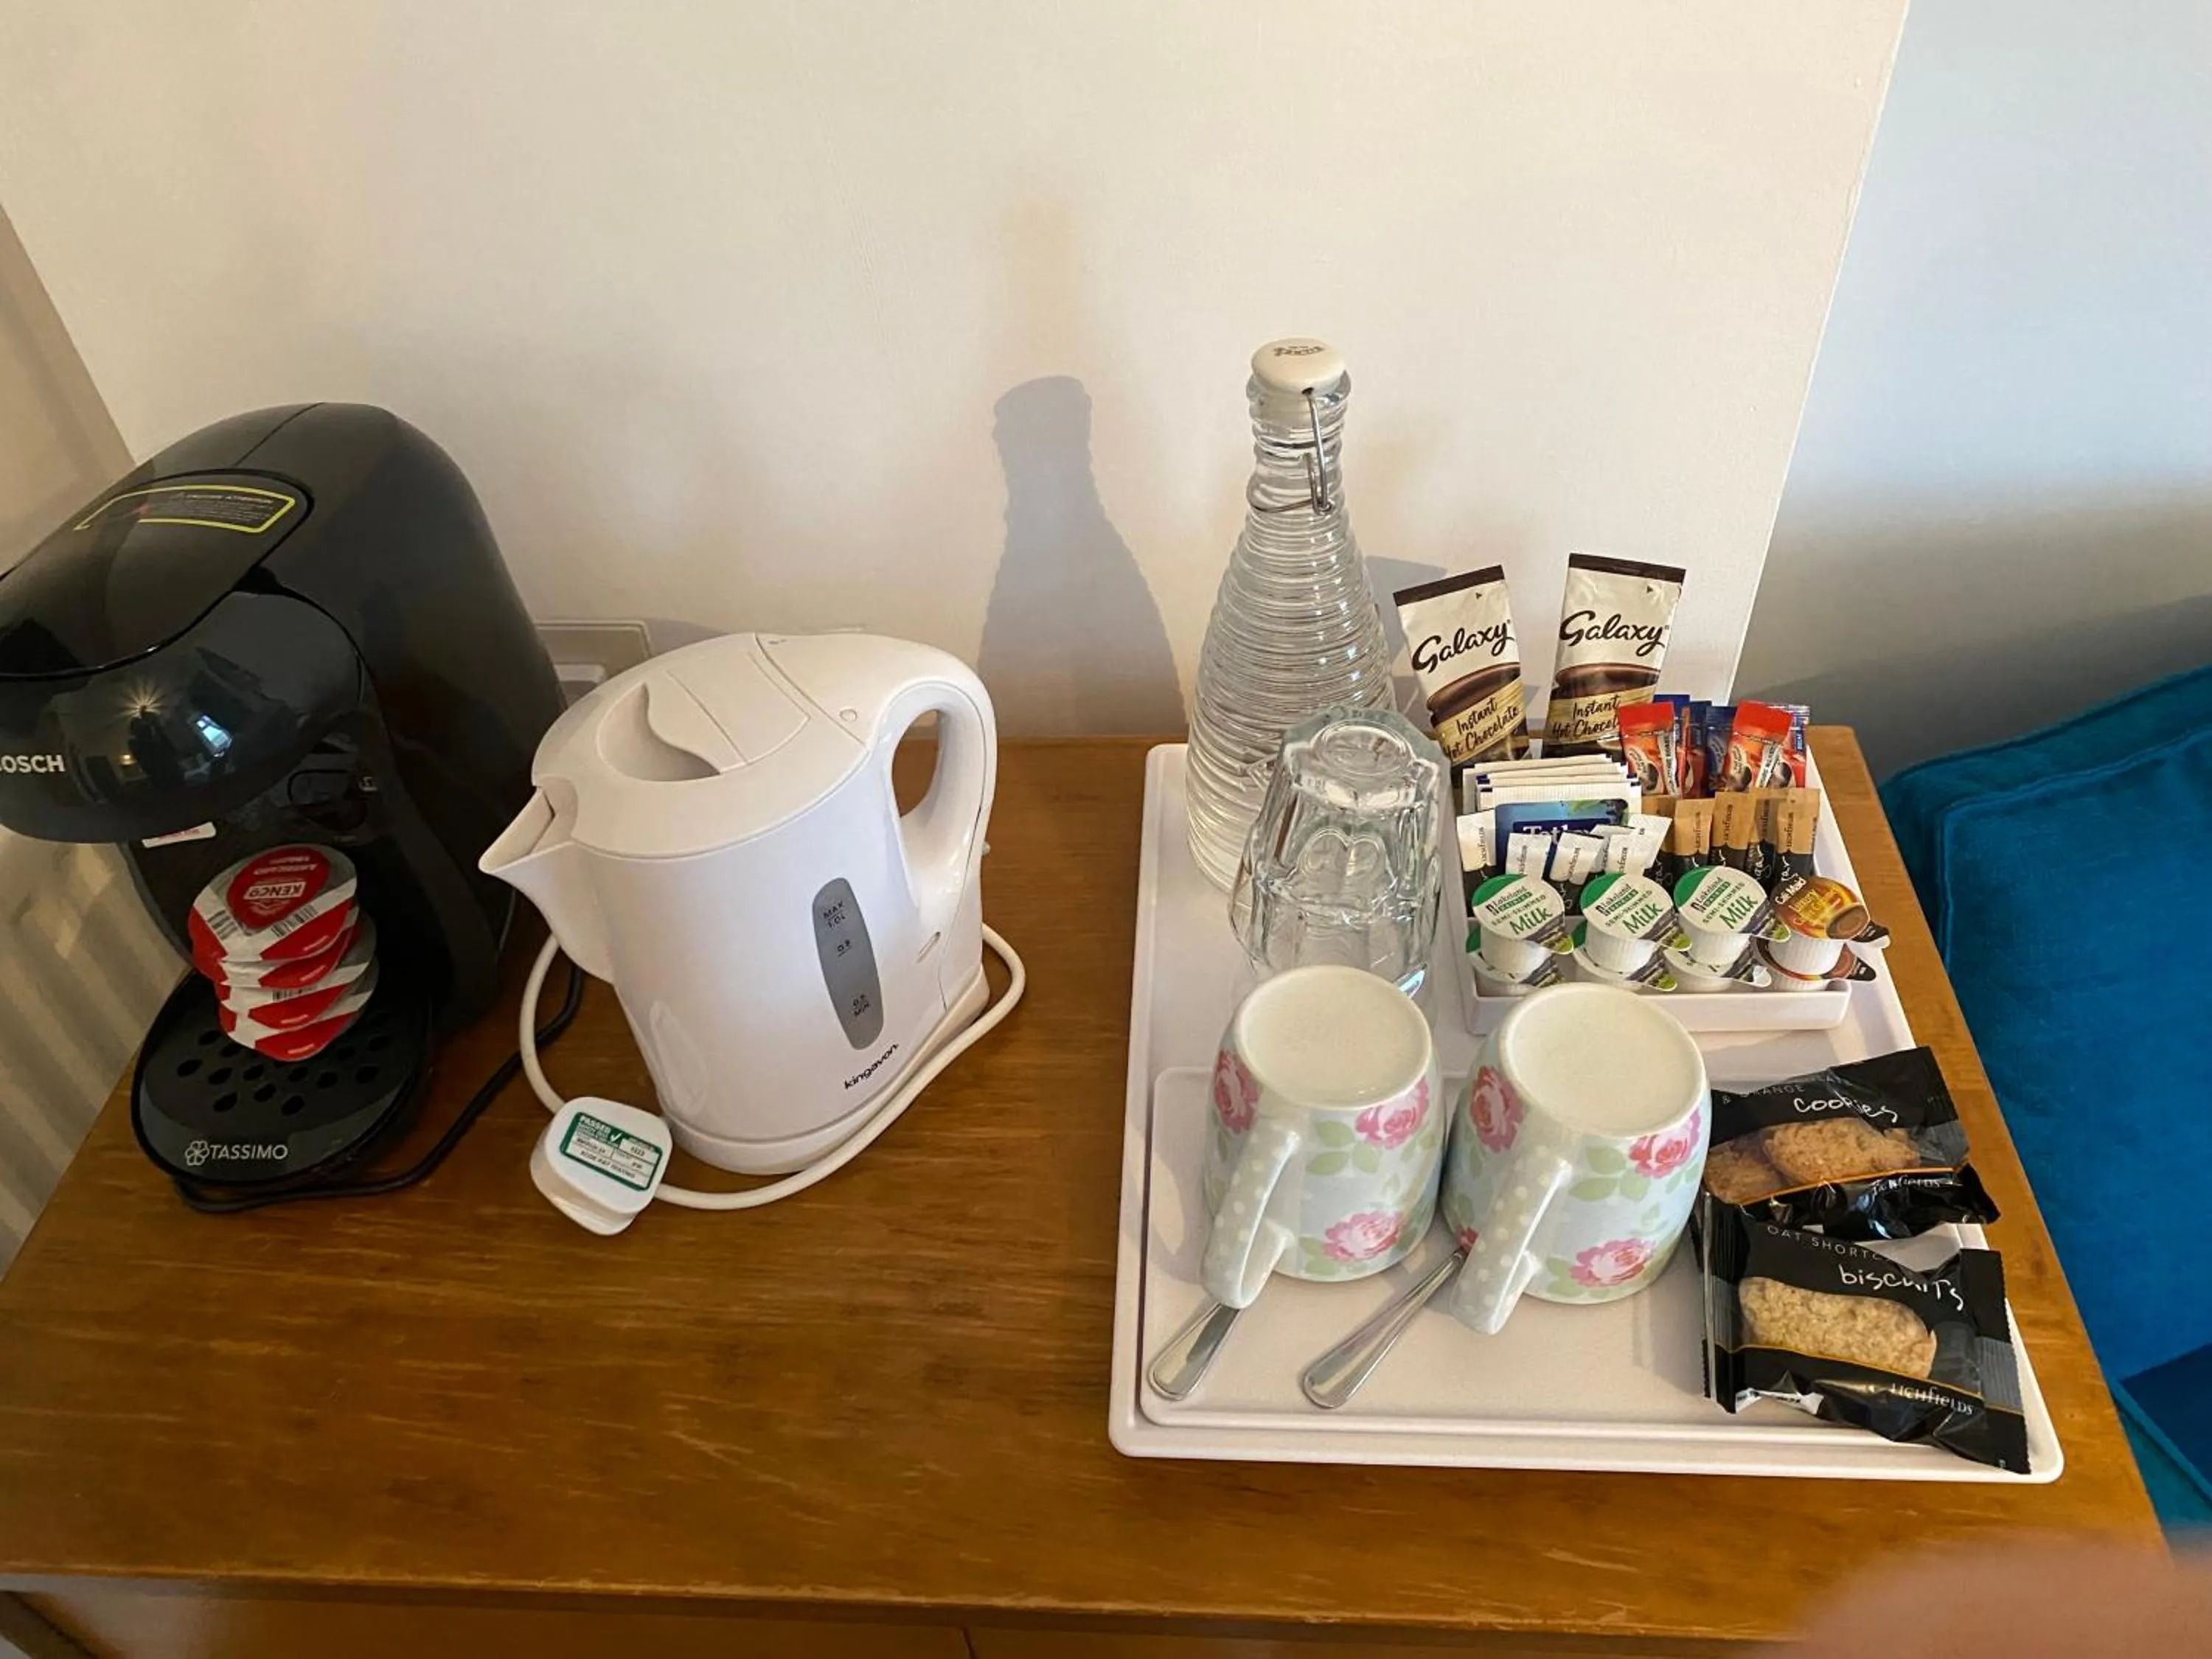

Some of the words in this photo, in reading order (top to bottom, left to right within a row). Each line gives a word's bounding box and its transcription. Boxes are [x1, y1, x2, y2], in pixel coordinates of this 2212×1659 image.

[1411, 622, 1515, 673] Galaxy
[1559, 611, 1666, 657] Galaxy
[1456, 697, 1498, 735] Instant
[1573, 695, 1621, 720] Instant
[1443, 742, 1463, 764] Hot
[1465, 706, 1519, 751] Chocolate
[1552, 722, 1571, 740] Hot
[1574, 714, 1620, 739] Chocol
[0, 754, 66, 773] OSCH
[248, 883, 304, 898] KENCO
[822, 900, 844, 919] MAX
[1509, 907, 1553, 935] Milk
[1622, 902, 1663, 934] Milk
[1719, 895, 1759, 929] Milk
[844, 1043, 899, 1091] kingavon
[209, 1144, 288, 1160] TASSIMO
[1767, 1225, 1801, 1242] OAT
